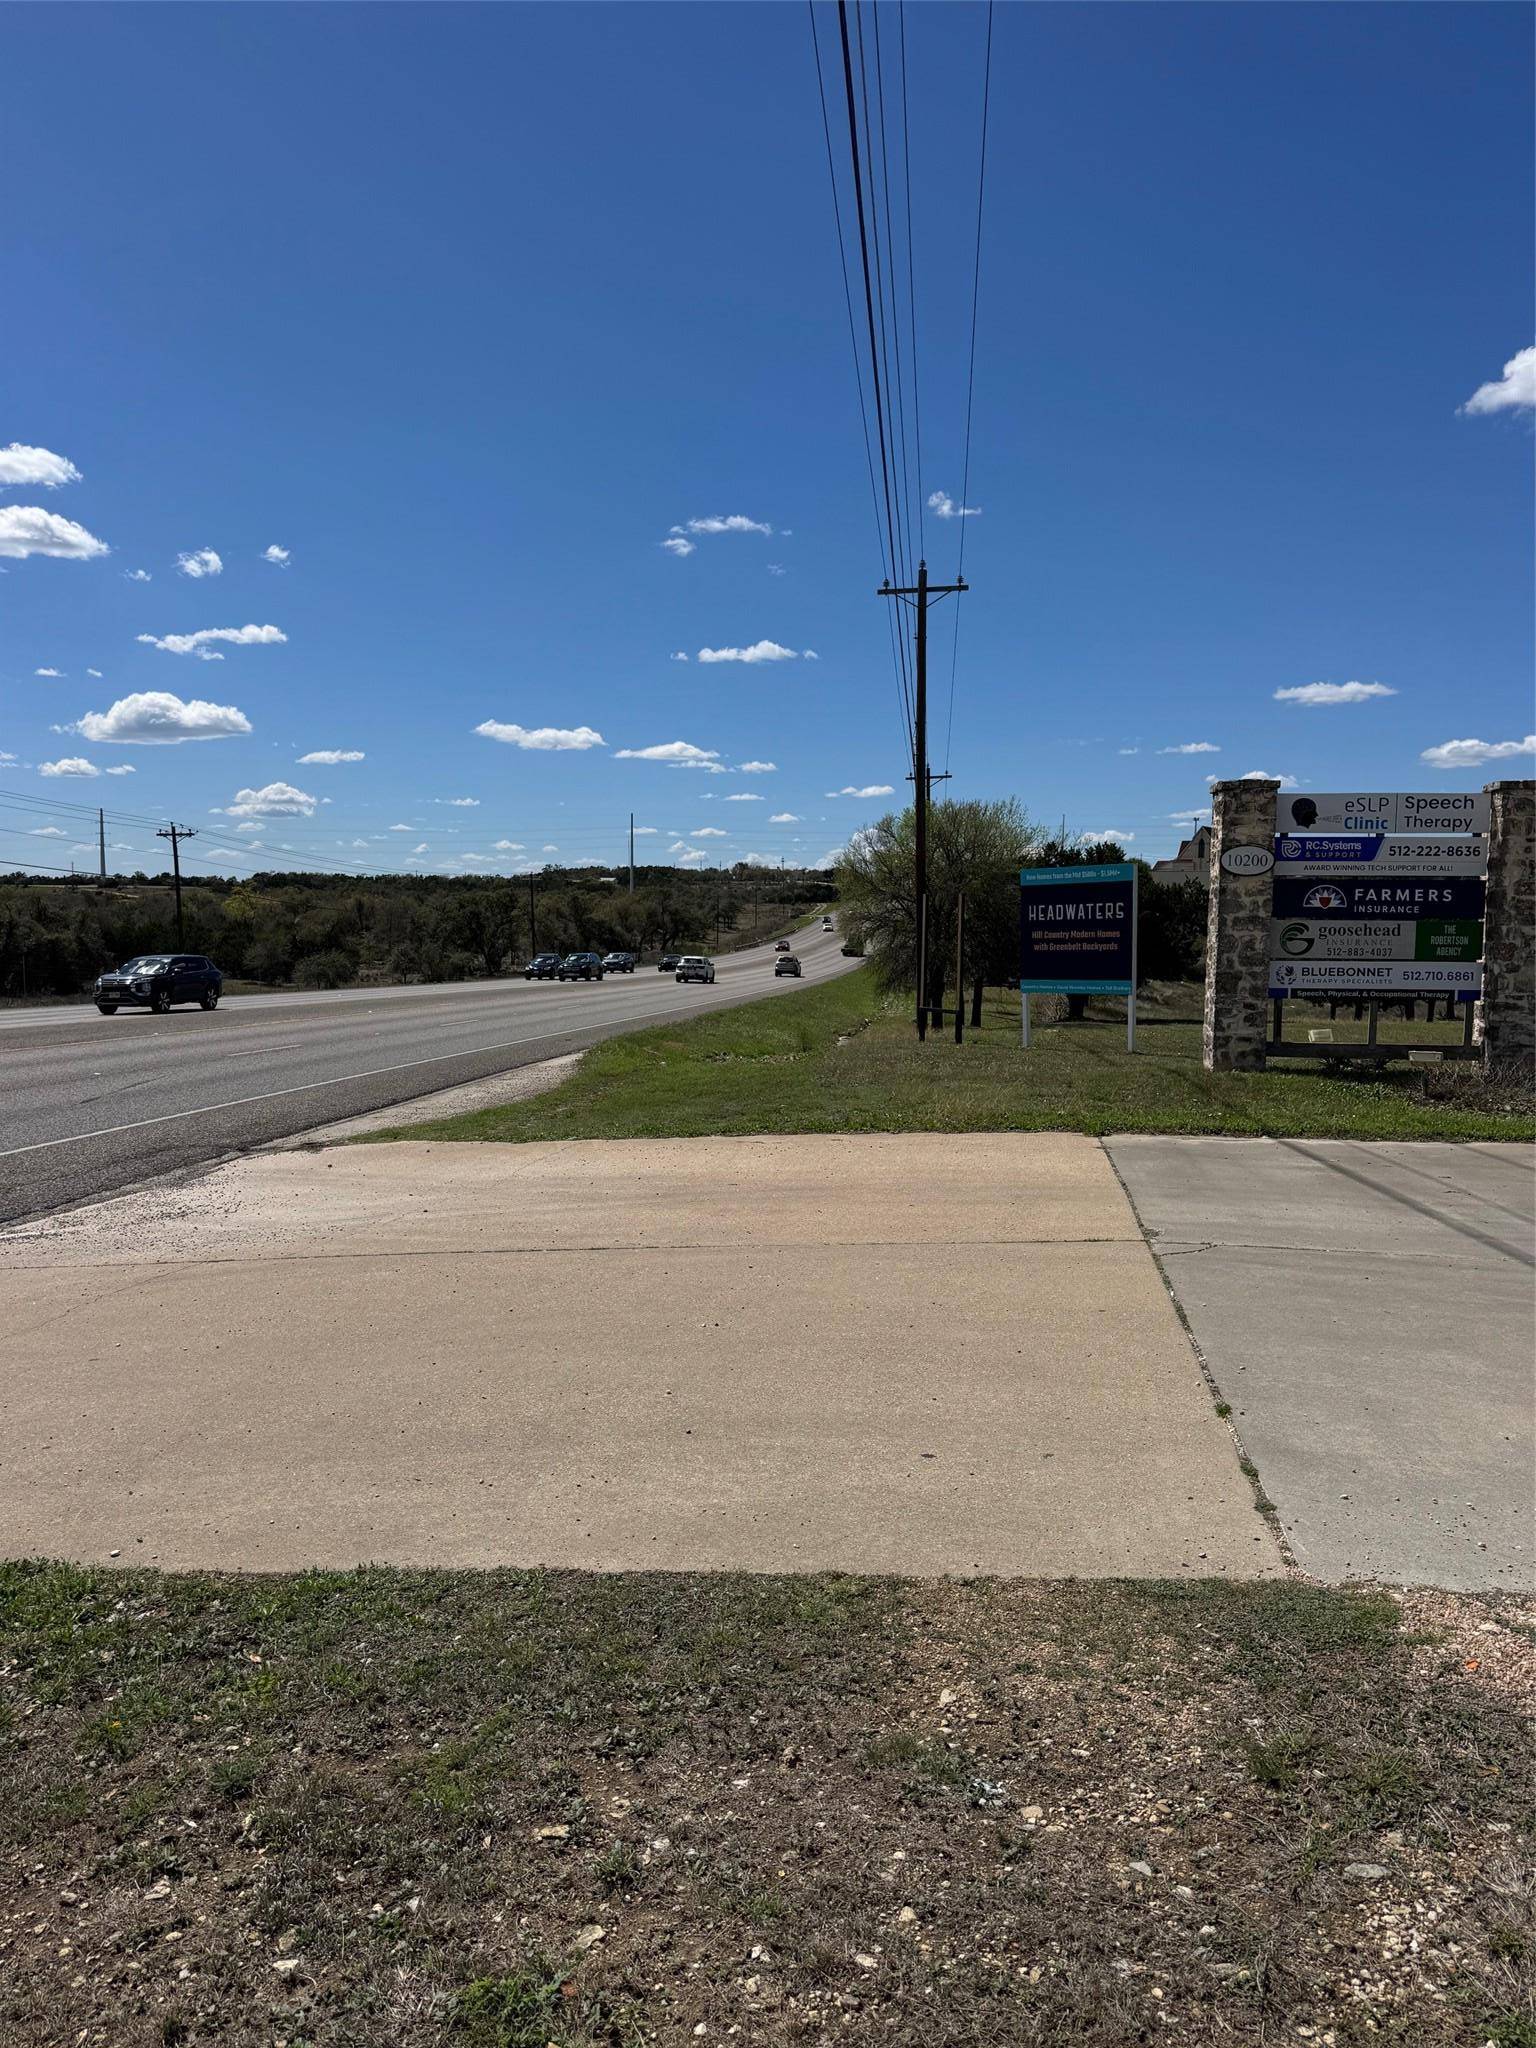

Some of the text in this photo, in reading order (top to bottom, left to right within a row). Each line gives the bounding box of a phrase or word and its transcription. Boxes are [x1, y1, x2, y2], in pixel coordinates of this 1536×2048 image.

[1345, 797, 1389, 812] eSLP
[1405, 796, 1475, 814] Speech
[1344, 816, 1388, 830] Clinic
[1404, 815, 1473, 832] Therapy
[1388, 845, 1481, 857] 512-222-8636
[1228, 854, 1268, 867] 10200
[1354, 888, 1452, 902] FARMERS
[1028, 903, 1125, 920] HEADWATERS
[1354, 905, 1420, 913] INSURANCE
[1318, 924, 1401, 939] goosehead
[1444, 925, 1457, 934] THE
[1032, 930, 1120, 940] Hill Country Modern Homes
[1430, 935, 1469, 945] ROBERTSON
[1034, 942, 1118, 952] with Greenbelt Backyards
[1327, 947, 1393, 957] 512-883-4037
[1436, 946, 1462, 956] AGENCY
[1301, 967, 1393, 977] BLUEBONNET
[1402, 971, 1474, 981] 512.710.6861
[1297, 990, 1326, 998] Speech,
[1327, 990, 1361, 998] Physical,
[1419, 991, 1450, 999] Therapy
